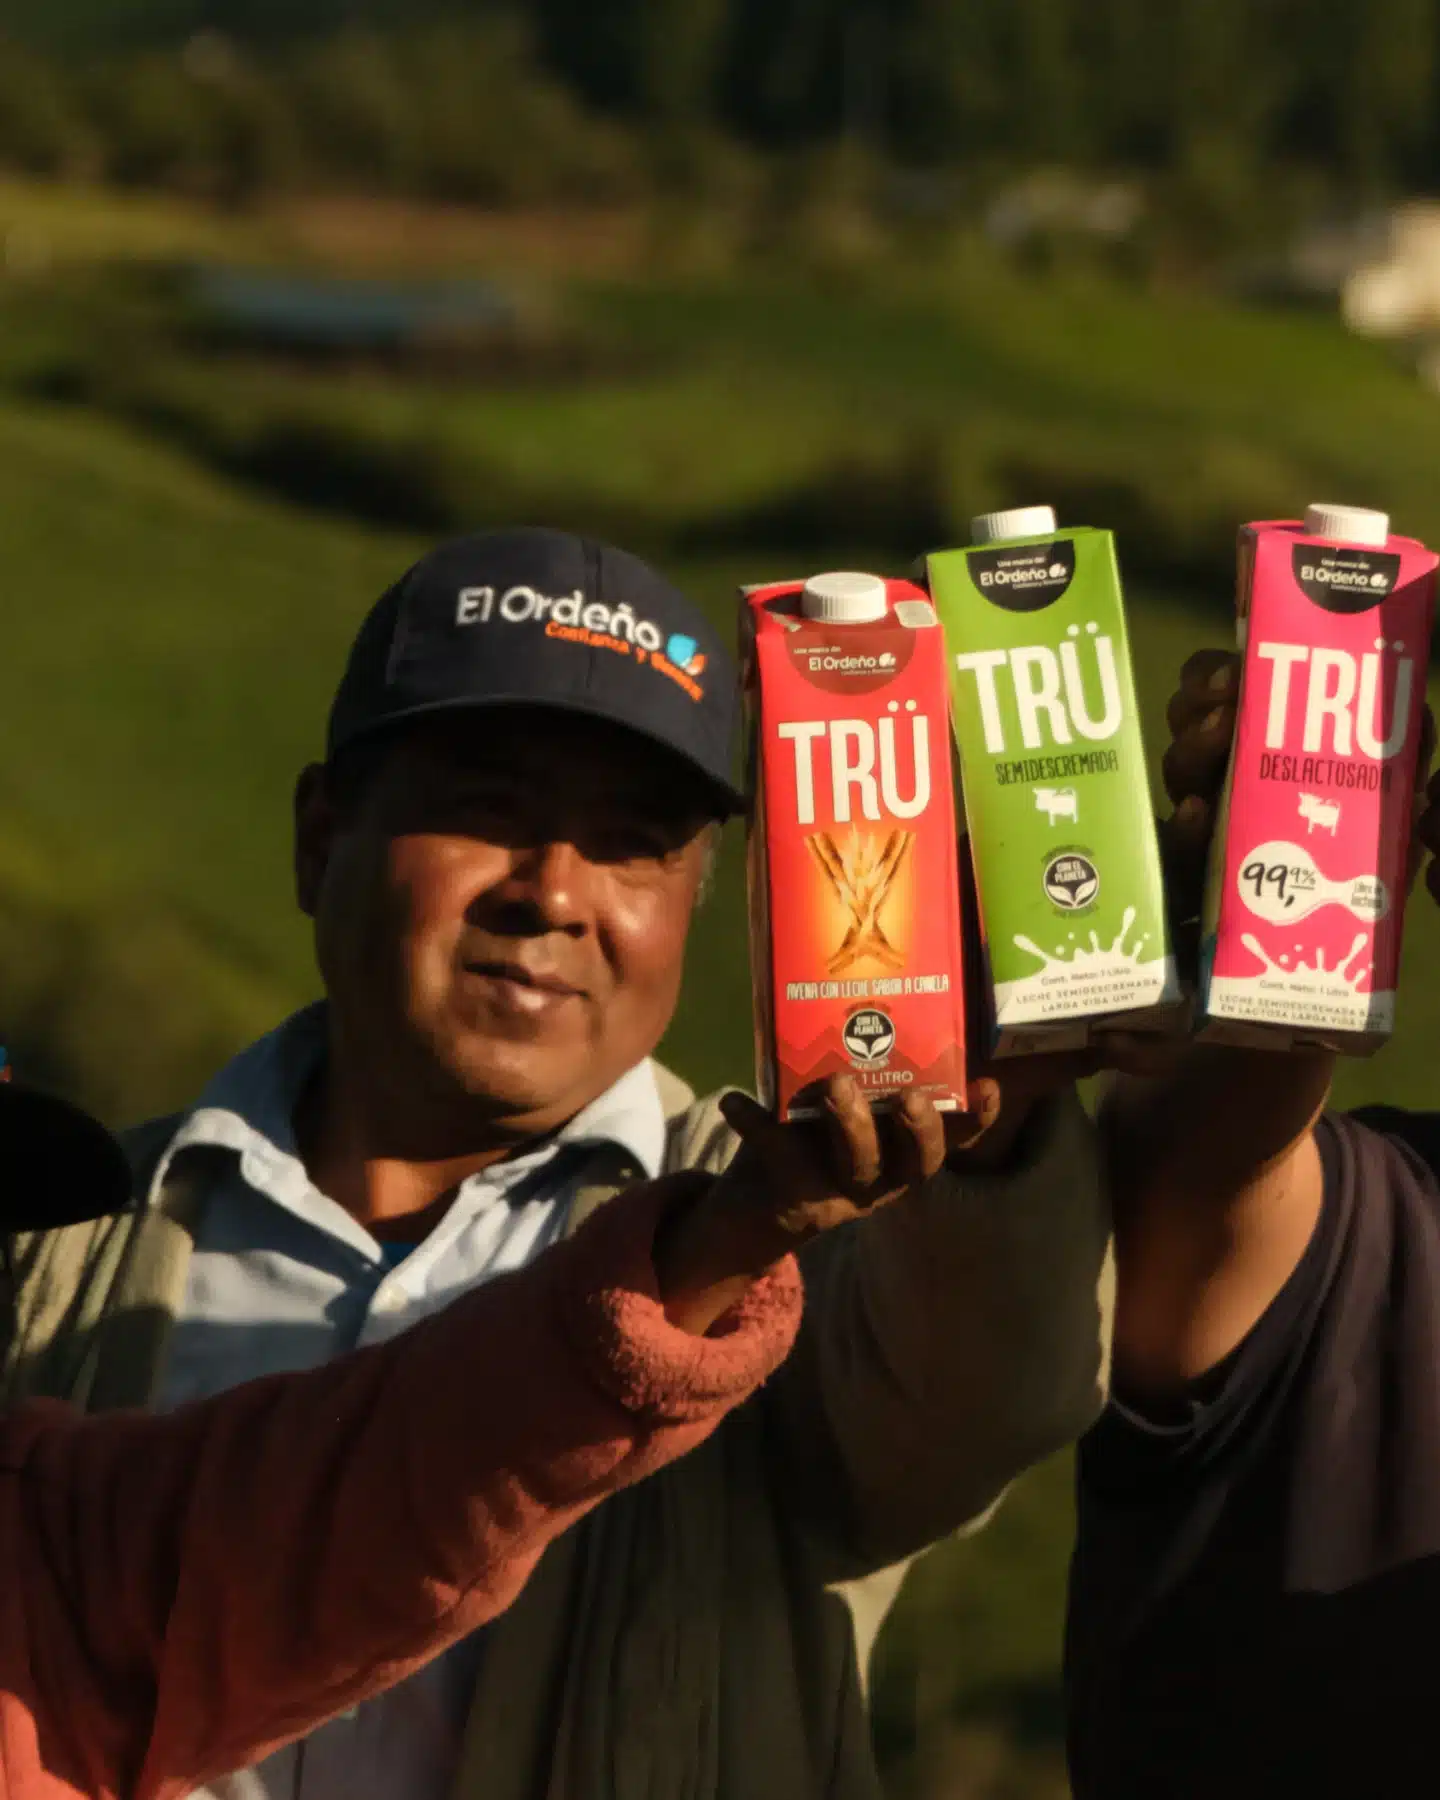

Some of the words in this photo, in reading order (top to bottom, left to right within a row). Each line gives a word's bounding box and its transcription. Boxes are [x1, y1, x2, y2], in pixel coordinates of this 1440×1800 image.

[980, 571, 994, 586] El
[995, 568, 1047, 585] Ordeño
[1301, 566, 1314, 580] El
[1315, 568, 1368, 585] Ordeño
[456, 586, 494, 625] El
[500, 586, 660, 651] Ordeño
[808, 656, 821, 671] El
[823, 655, 876, 670] Ordeño
[956, 621, 1122, 754] TRÜ
[1257, 637, 1414, 760] TRÜ
[778, 700, 930, 824] TRÜ
[995, 750, 1119, 786] SEMIDESCREMADA
[1259, 753, 1393, 791] DESLACTOSADA
[786, 982, 818, 1000] AVENA
[820, 981, 838, 998] CON
[841, 979, 868, 998] LECHE
[872, 978, 902, 996] SABOR
[904, 977, 912, 995] A
[872, 1071, 914, 1085] LITRO
